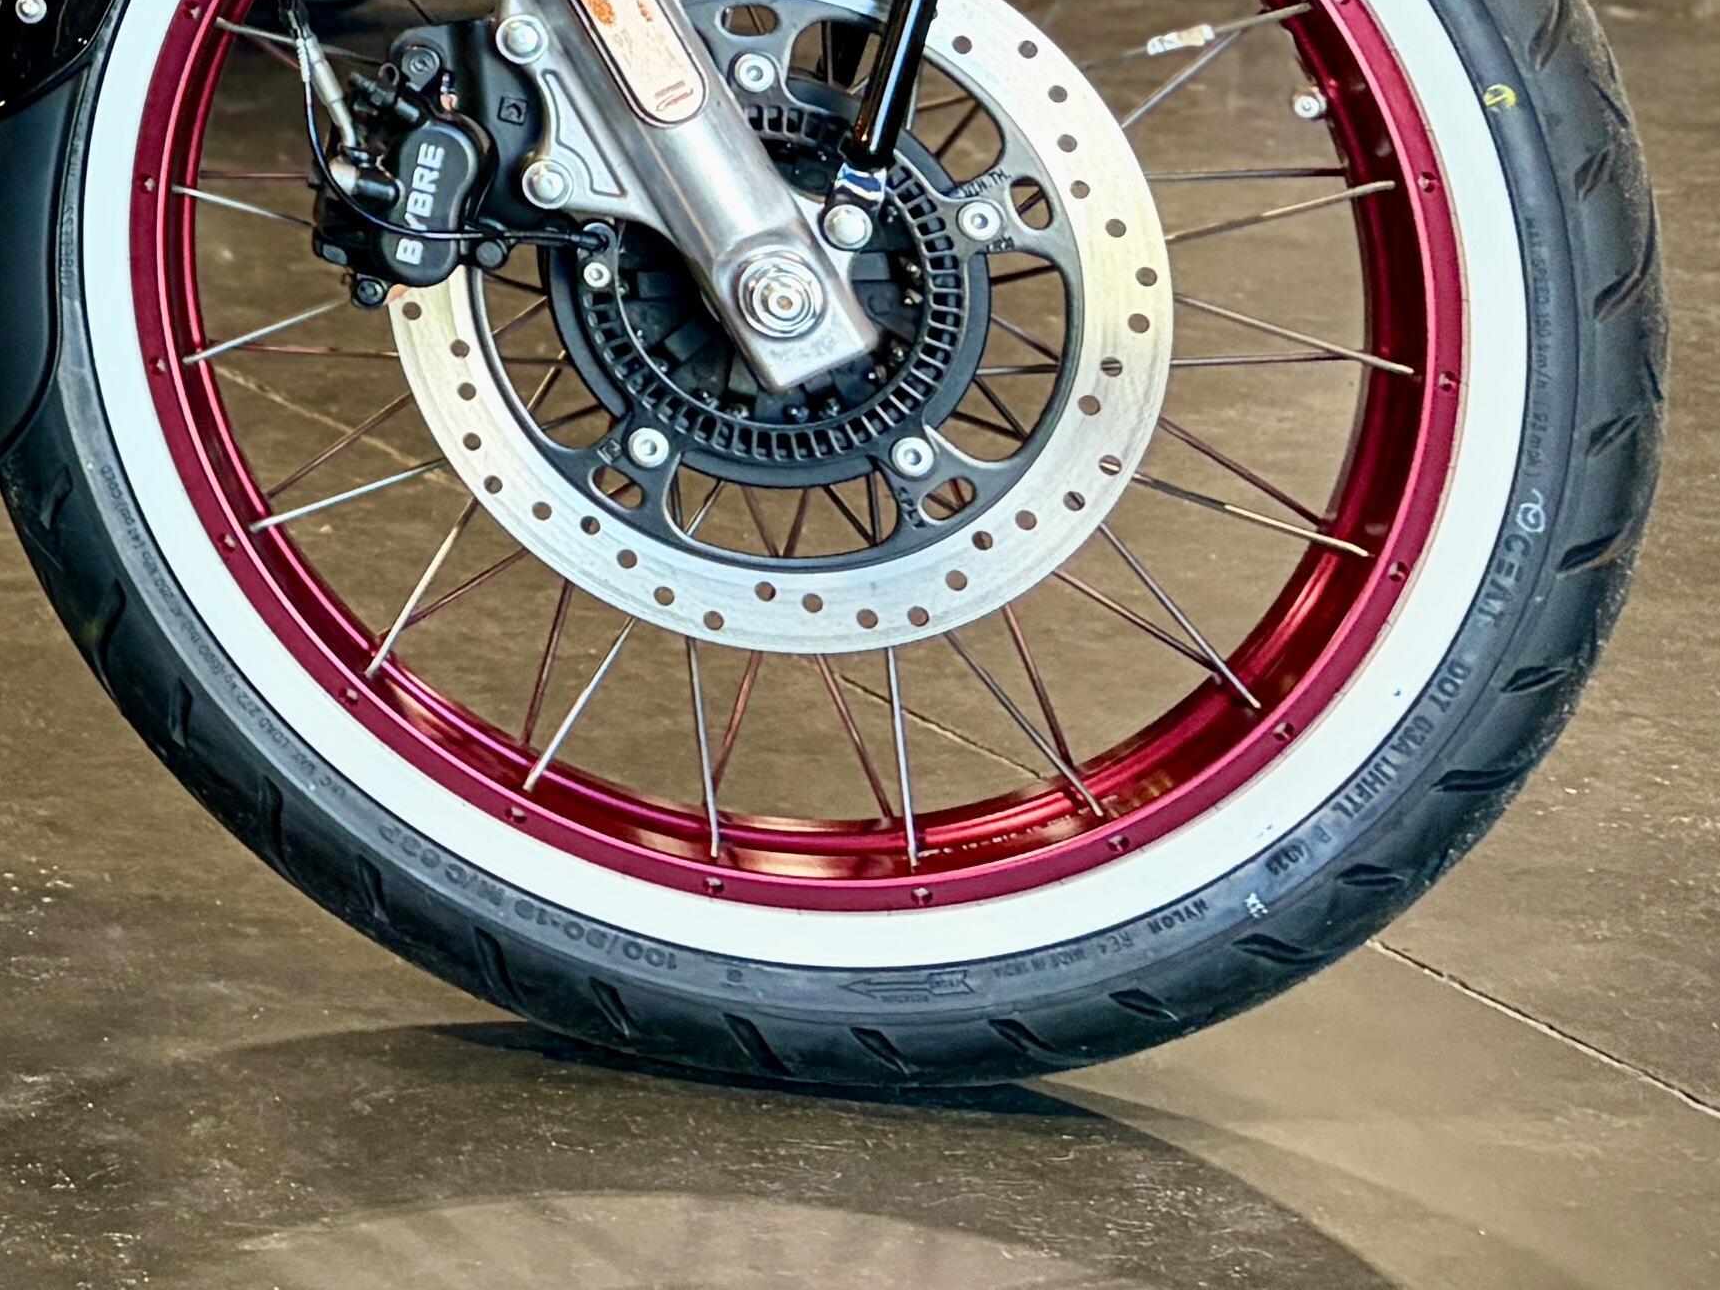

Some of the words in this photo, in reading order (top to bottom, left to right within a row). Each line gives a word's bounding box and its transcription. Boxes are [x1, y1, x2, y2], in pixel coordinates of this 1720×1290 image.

[395, 142, 446, 265] BYBRE
[97, 461, 125, 502] COLD
[1473, 529, 1535, 630] CEAT
[1424, 656, 1475, 715] DOT
